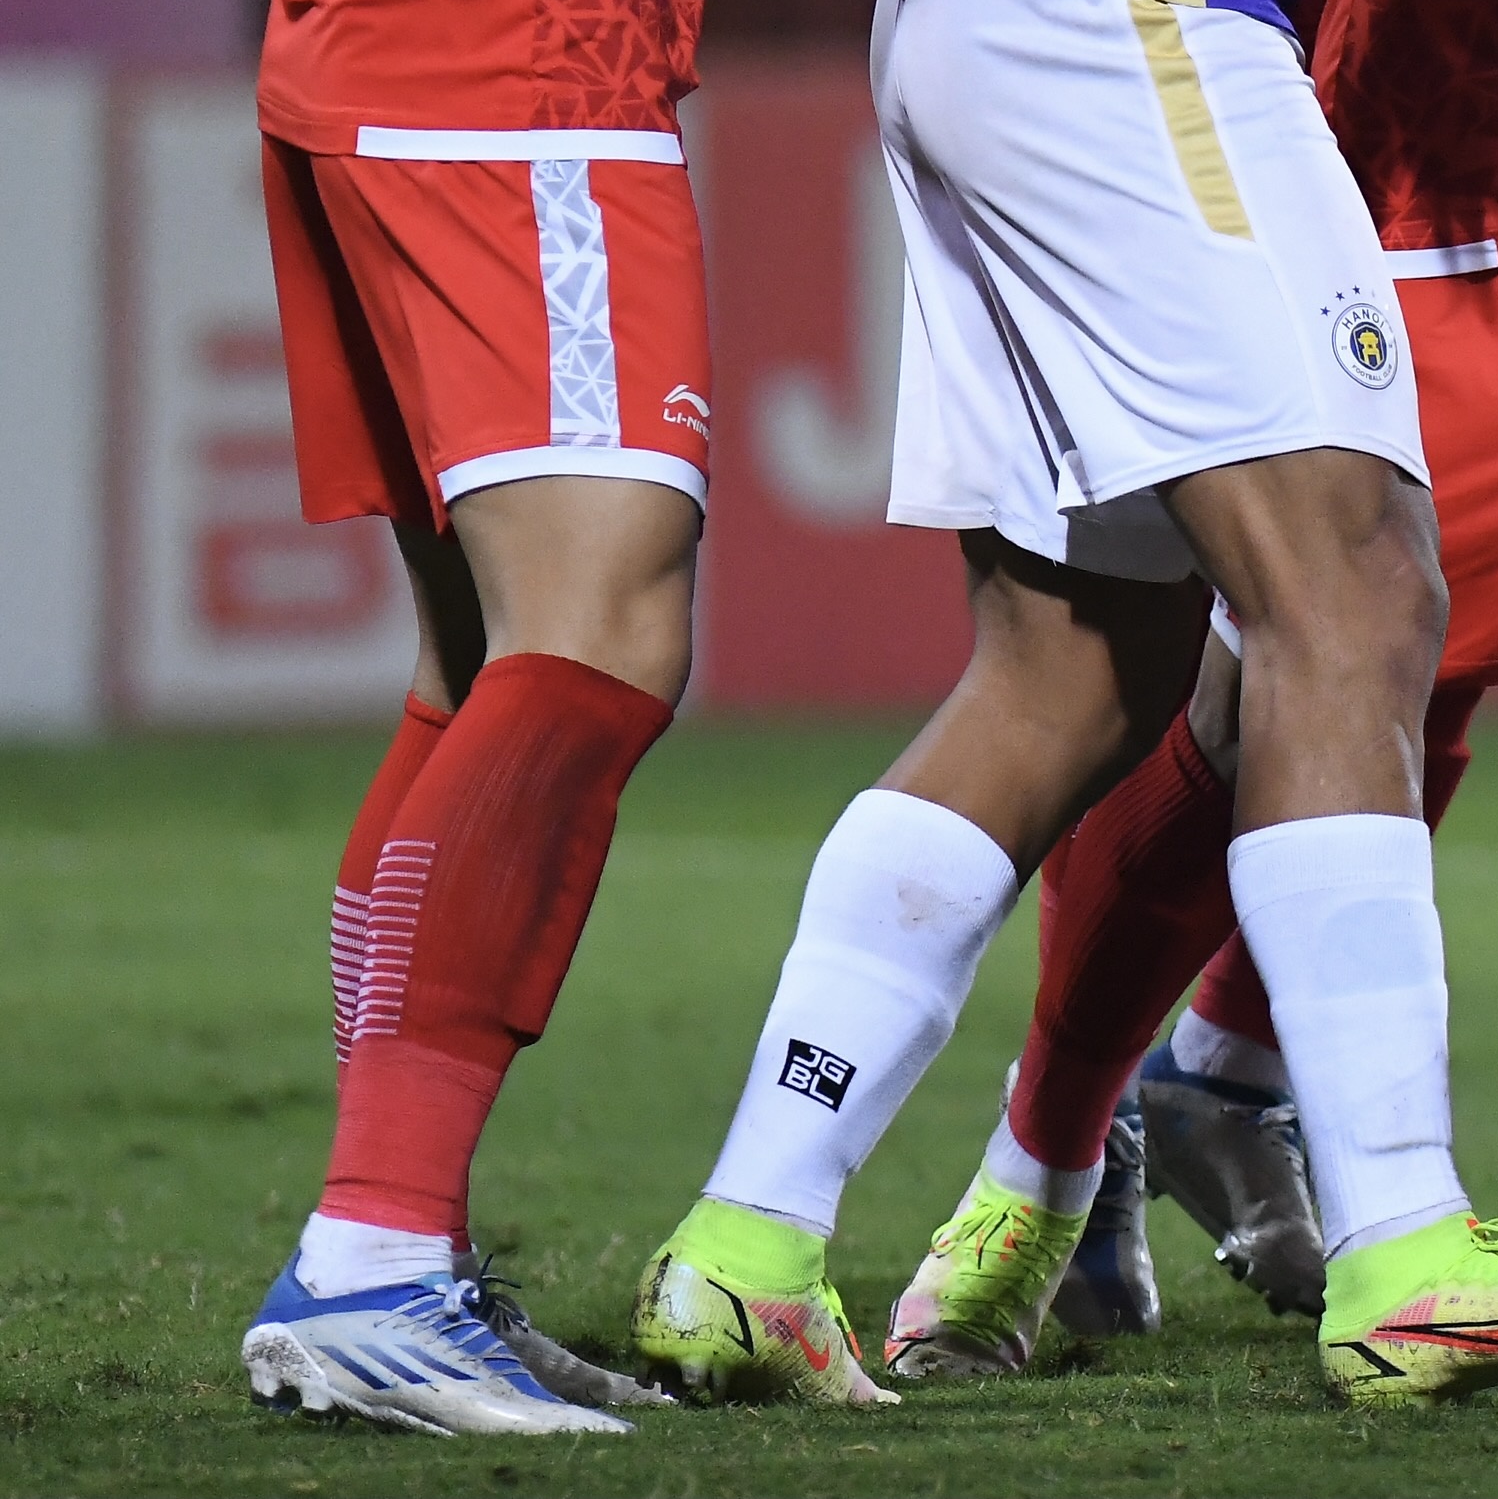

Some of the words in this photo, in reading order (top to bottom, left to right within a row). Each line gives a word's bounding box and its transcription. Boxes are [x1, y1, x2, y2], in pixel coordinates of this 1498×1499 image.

[1341, 308, 1385, 330] HANOI
[784, 1062, 835, 1106] BL
[792, 1046, 850, 1086] JG
